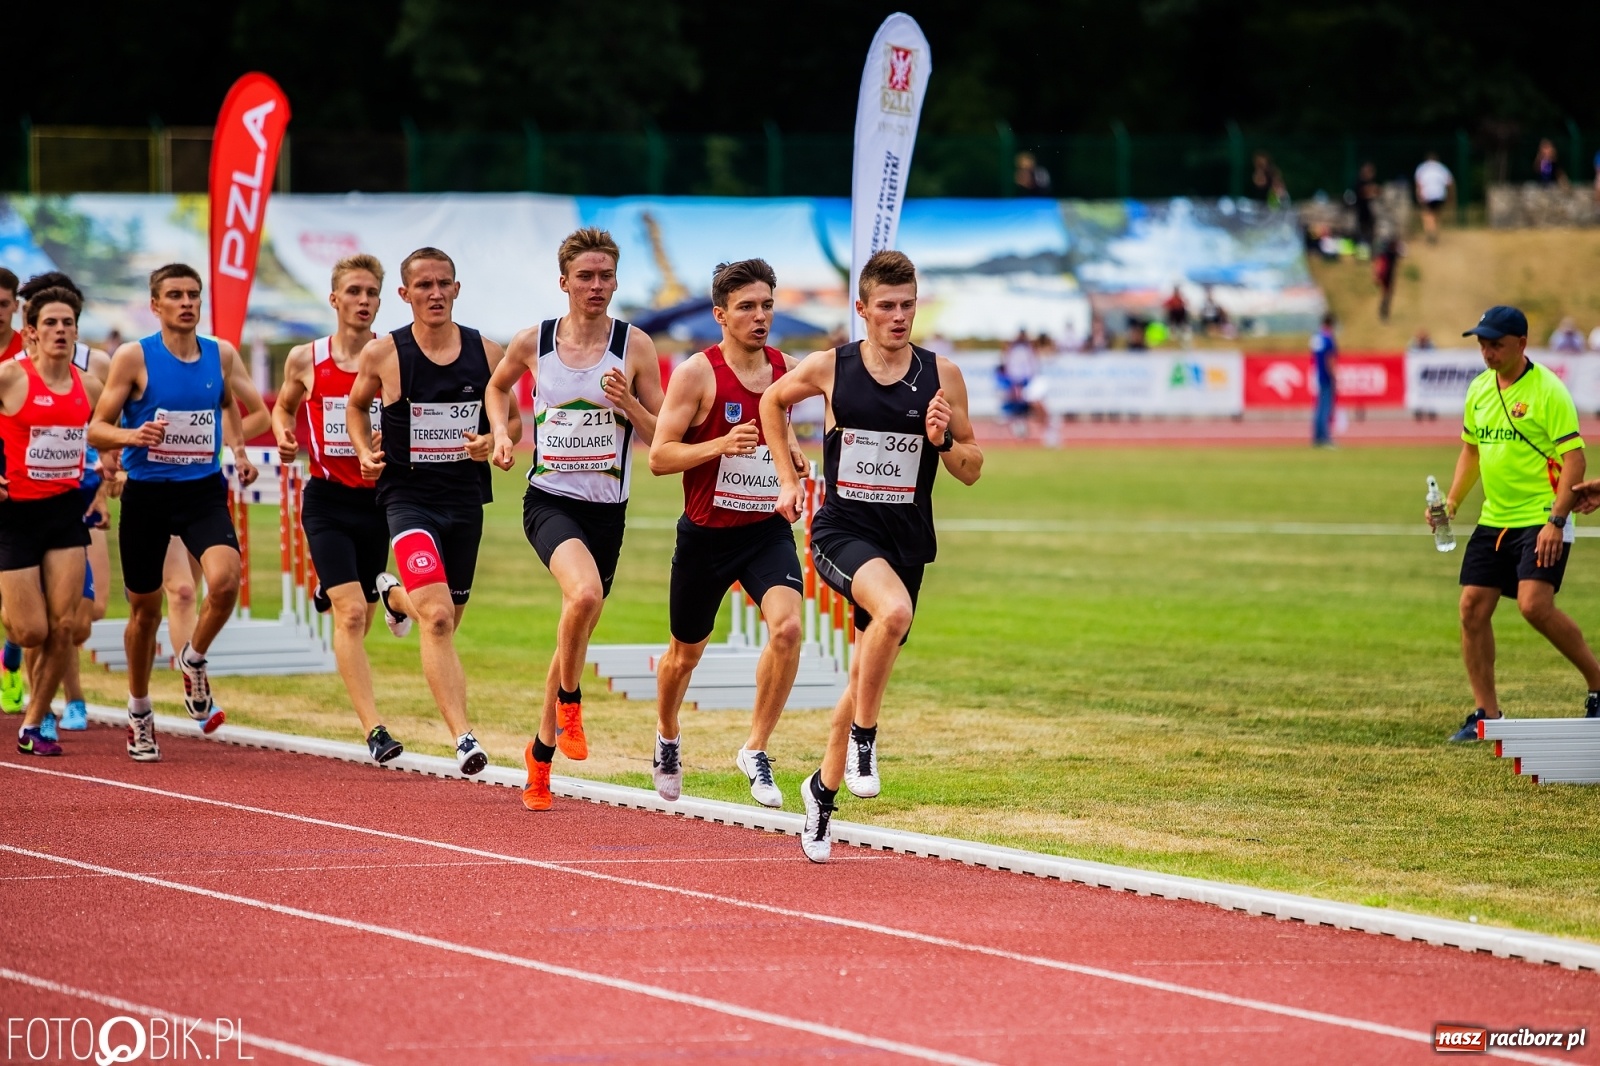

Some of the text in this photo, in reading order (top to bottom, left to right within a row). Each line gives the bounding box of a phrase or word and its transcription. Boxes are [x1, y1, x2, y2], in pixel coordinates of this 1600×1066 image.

[218, 99, 276, 280] PZLA
[450, 404, 479, 418] 367
[190, 412, 213, 426] 260
[583, 411, 613, 426] 211
[325, 423, 348, 433] OST
[162, 434, 212, 444] ERNACKI
[546, 435, 613, 449] SZKUDLAREK
[856, 439, 879, 447] Racibórz
[885, 436, 919, 453] 366
[418, 453, 455, 461] RACIBÓRZ
[762, 450, 774, 465] 4
[551, 462, 608, 470] RACIBÓRZ 2019
[856, 461, 901, 477] SOKÓŁ
[845, 490, 905, 501] RACIBÓRZ 2019
[722, 500, 759, 509] RACIBÓRZ
